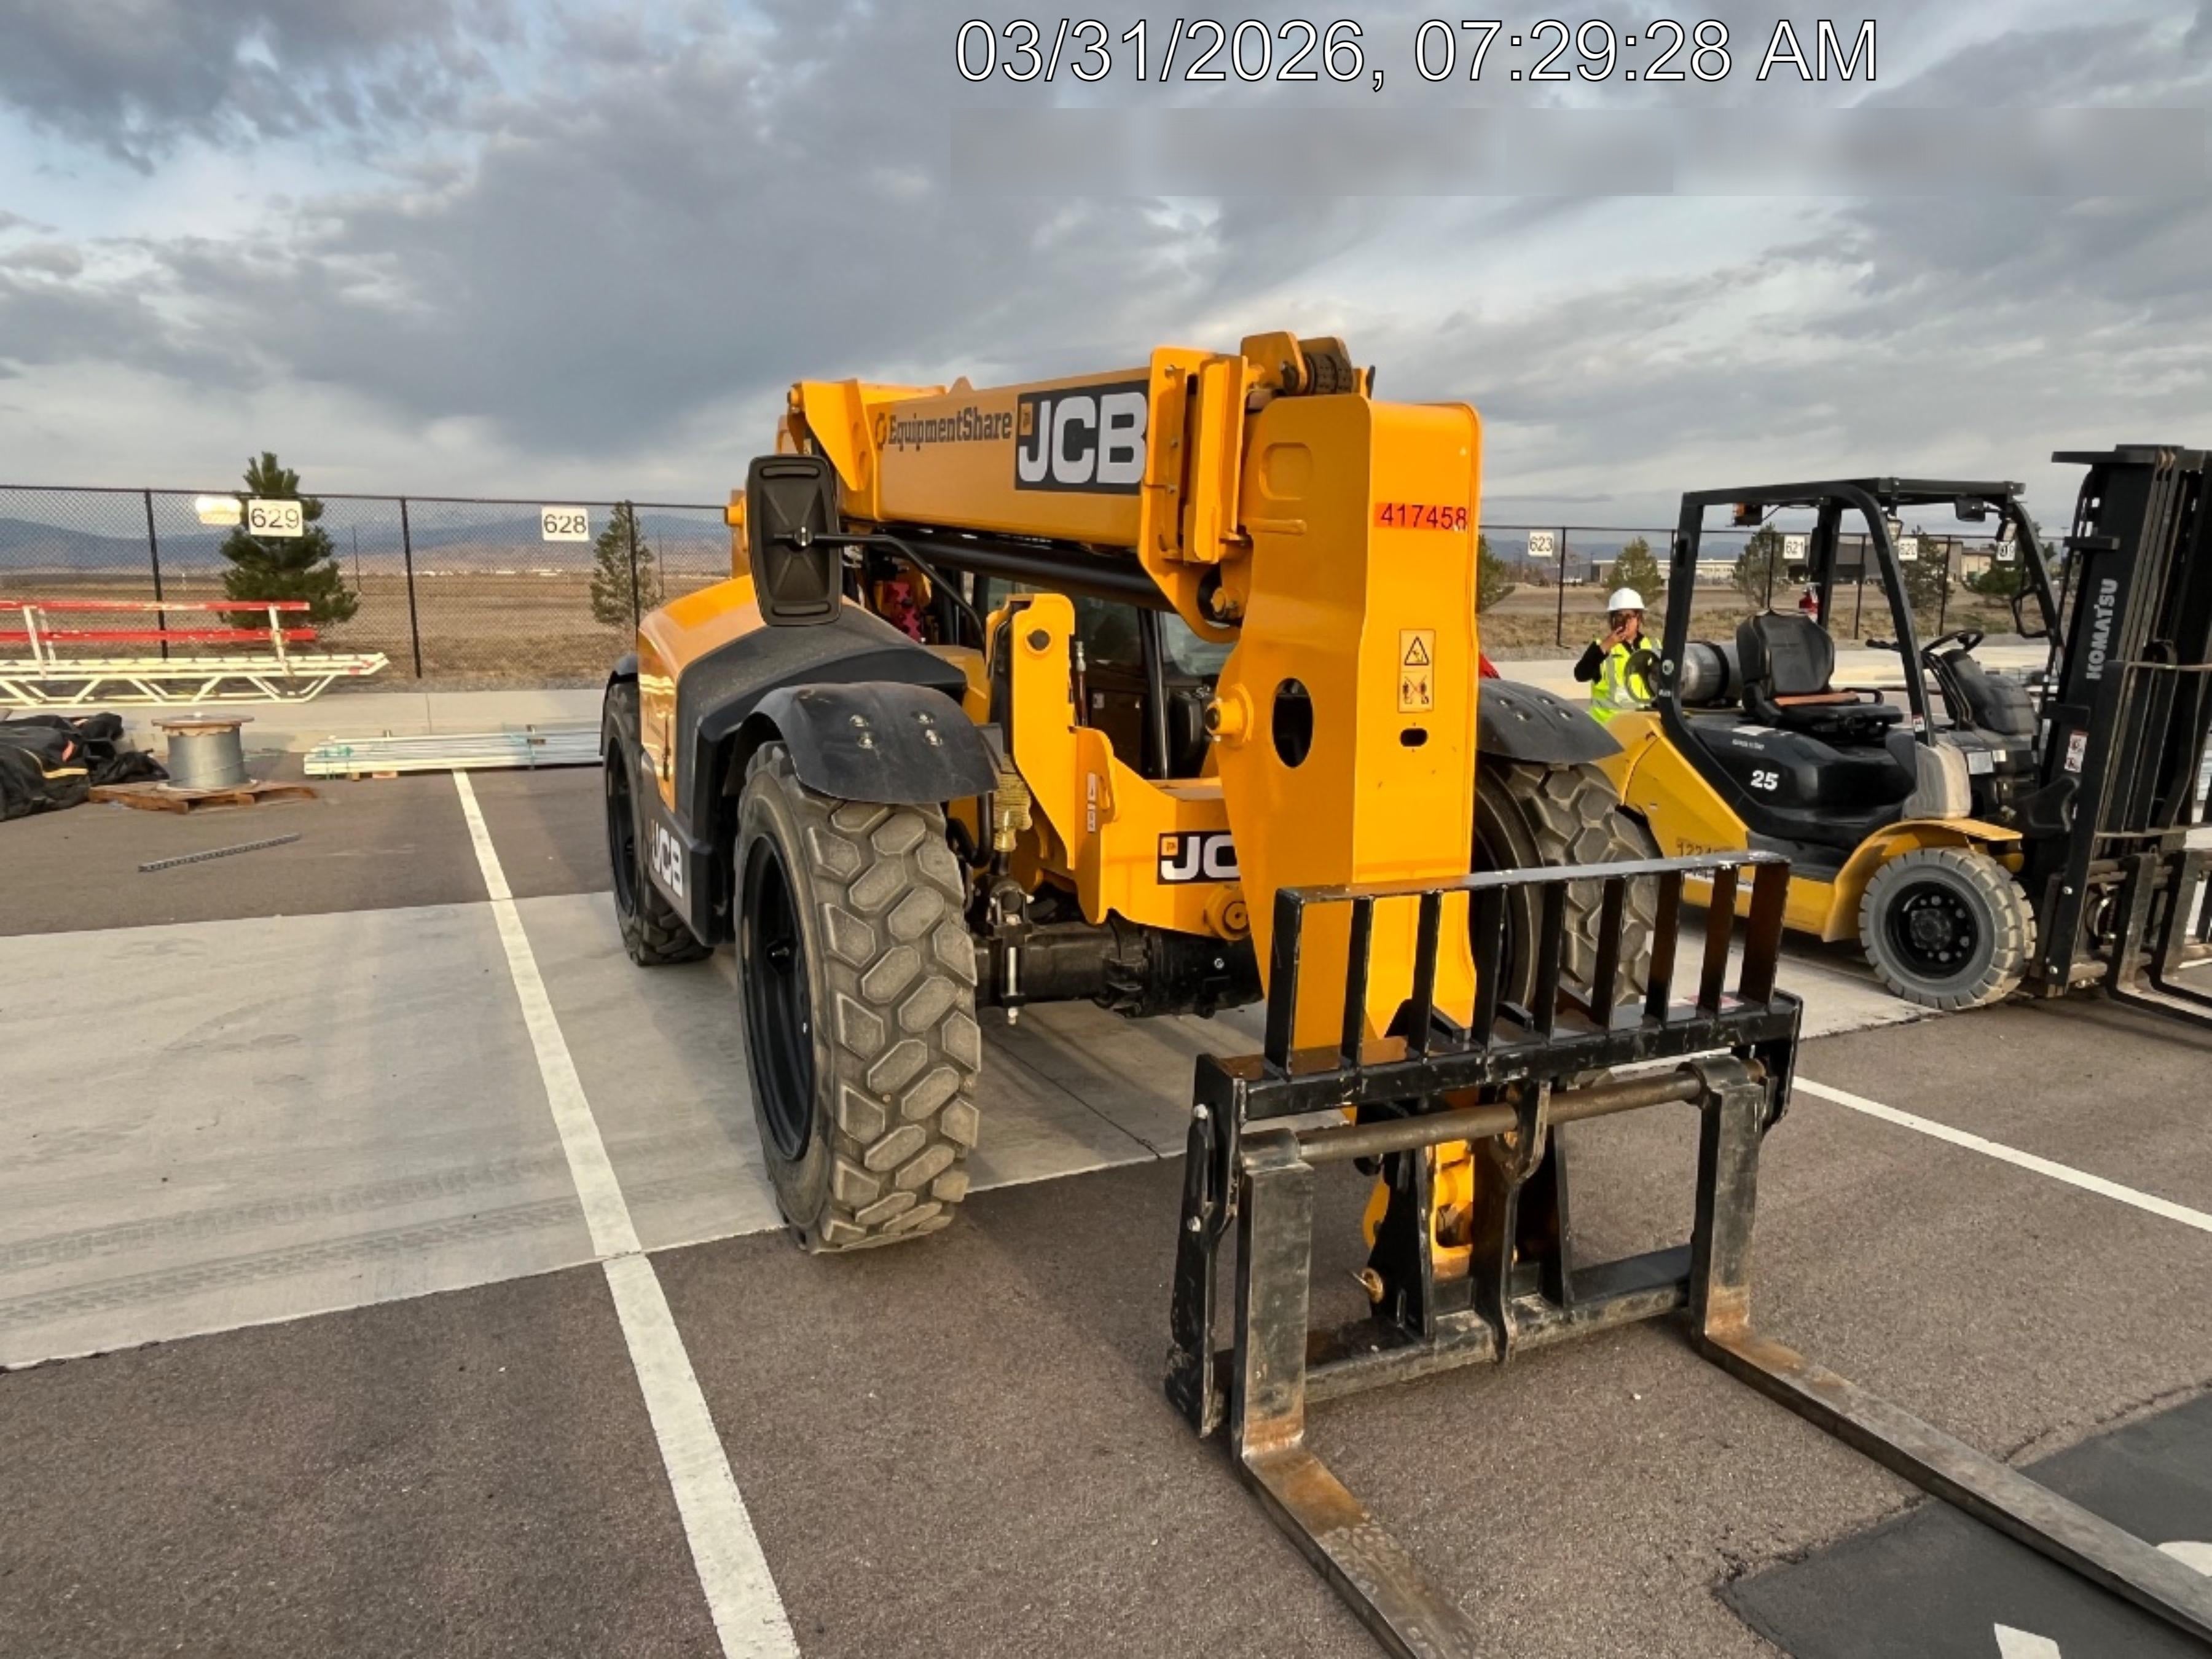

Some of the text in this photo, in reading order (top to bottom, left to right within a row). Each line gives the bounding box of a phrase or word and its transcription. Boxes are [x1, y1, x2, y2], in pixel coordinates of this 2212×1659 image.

[888, 406, 1013, 452] EquipmentShare
[1018, 392, 1148, 484] JCB
[251, 508, 299, 529] 629
[544, 514, 587, 533] 628
[1380, 503, 1468, 531] 417458
[1529, 536, 1553, 552] 623
[2086, 578, 2118, 680] KOMATSU
[1751, 769, 1779, 791] 25
[651, 820, 683, 898] JCB
[1161, 834, 1240, 880] JC
